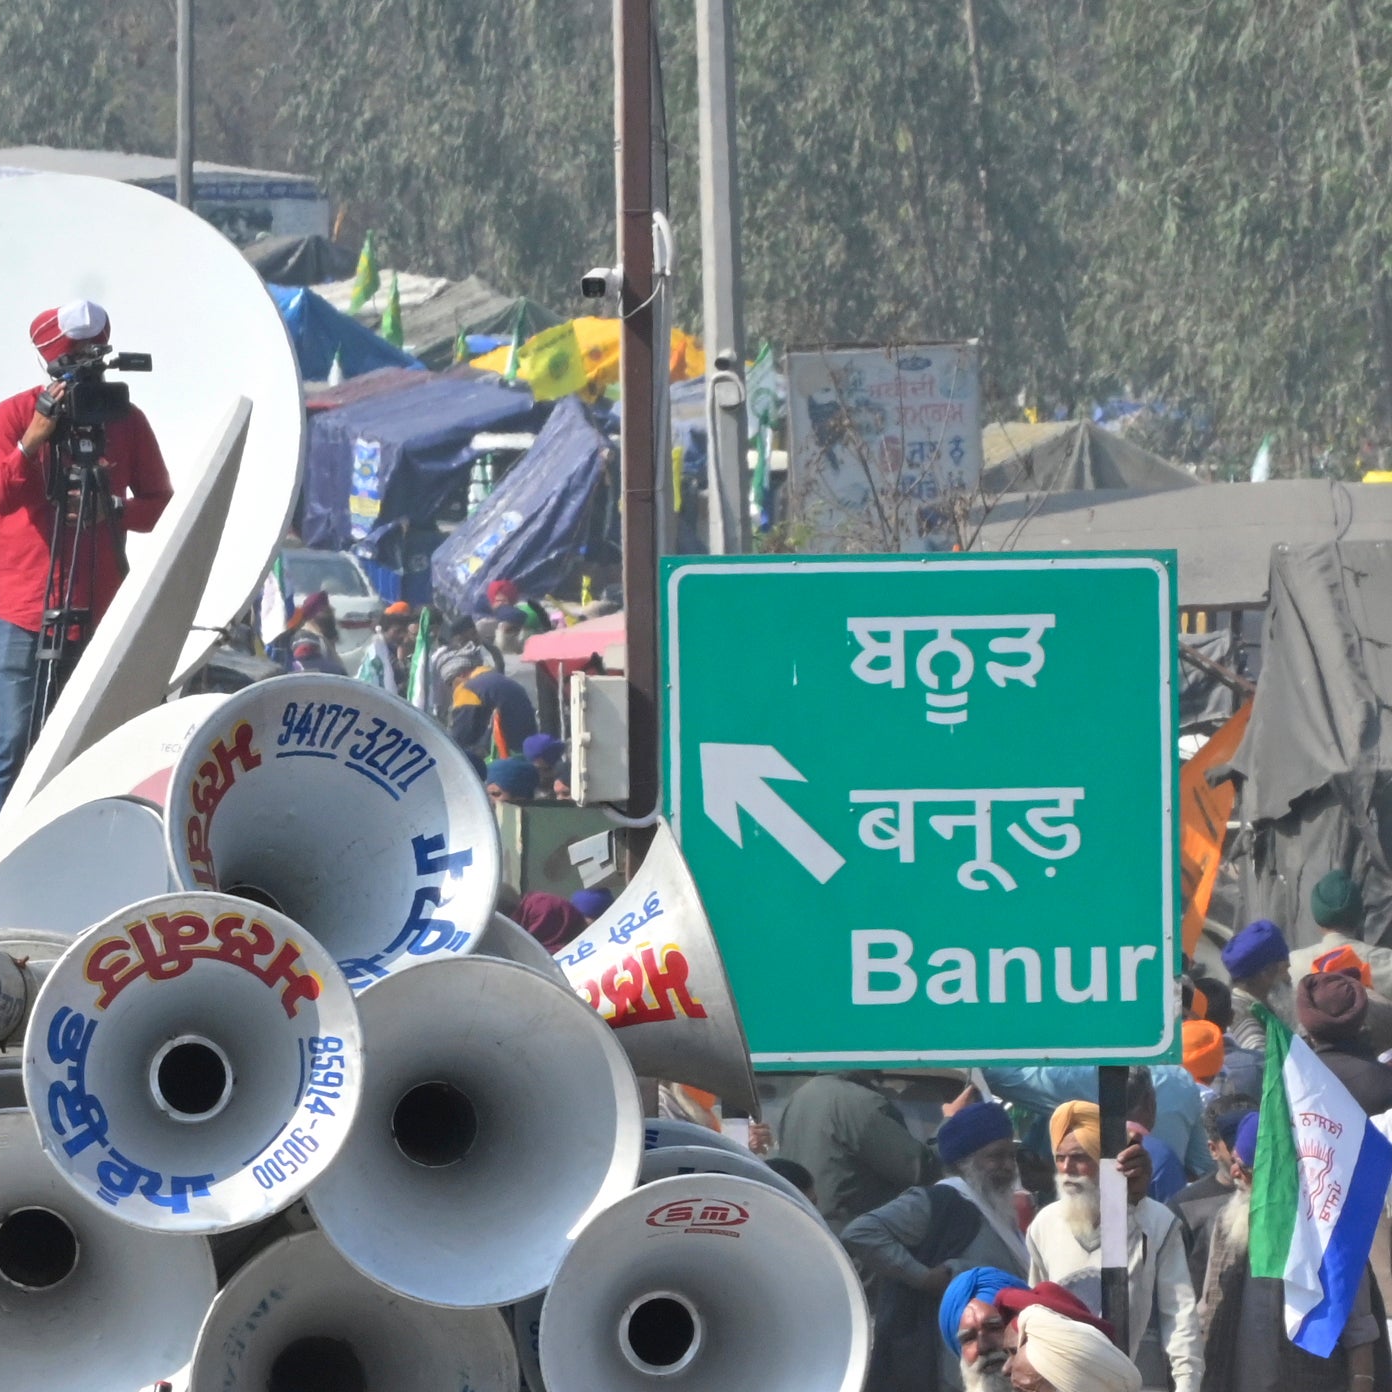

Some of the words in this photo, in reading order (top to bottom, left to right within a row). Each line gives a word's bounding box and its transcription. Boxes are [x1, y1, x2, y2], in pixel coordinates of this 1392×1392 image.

[847, 613, 1056, 726] ਬਨੂੜ
[277, 702, 437, 793] 94177-32171
[849, 786, 1085, 892] बनूड़
[83, 910, 324, 1019] ਮਲਕੀਤ
[850, 928, 1157, 1005] Banur
[47, 1005, 109, 1159] ਭਾਈ
[95, 1145, 216, 1214] ਰੂਪਾ
[252, 1035, 345, 1190] 85914-90500
